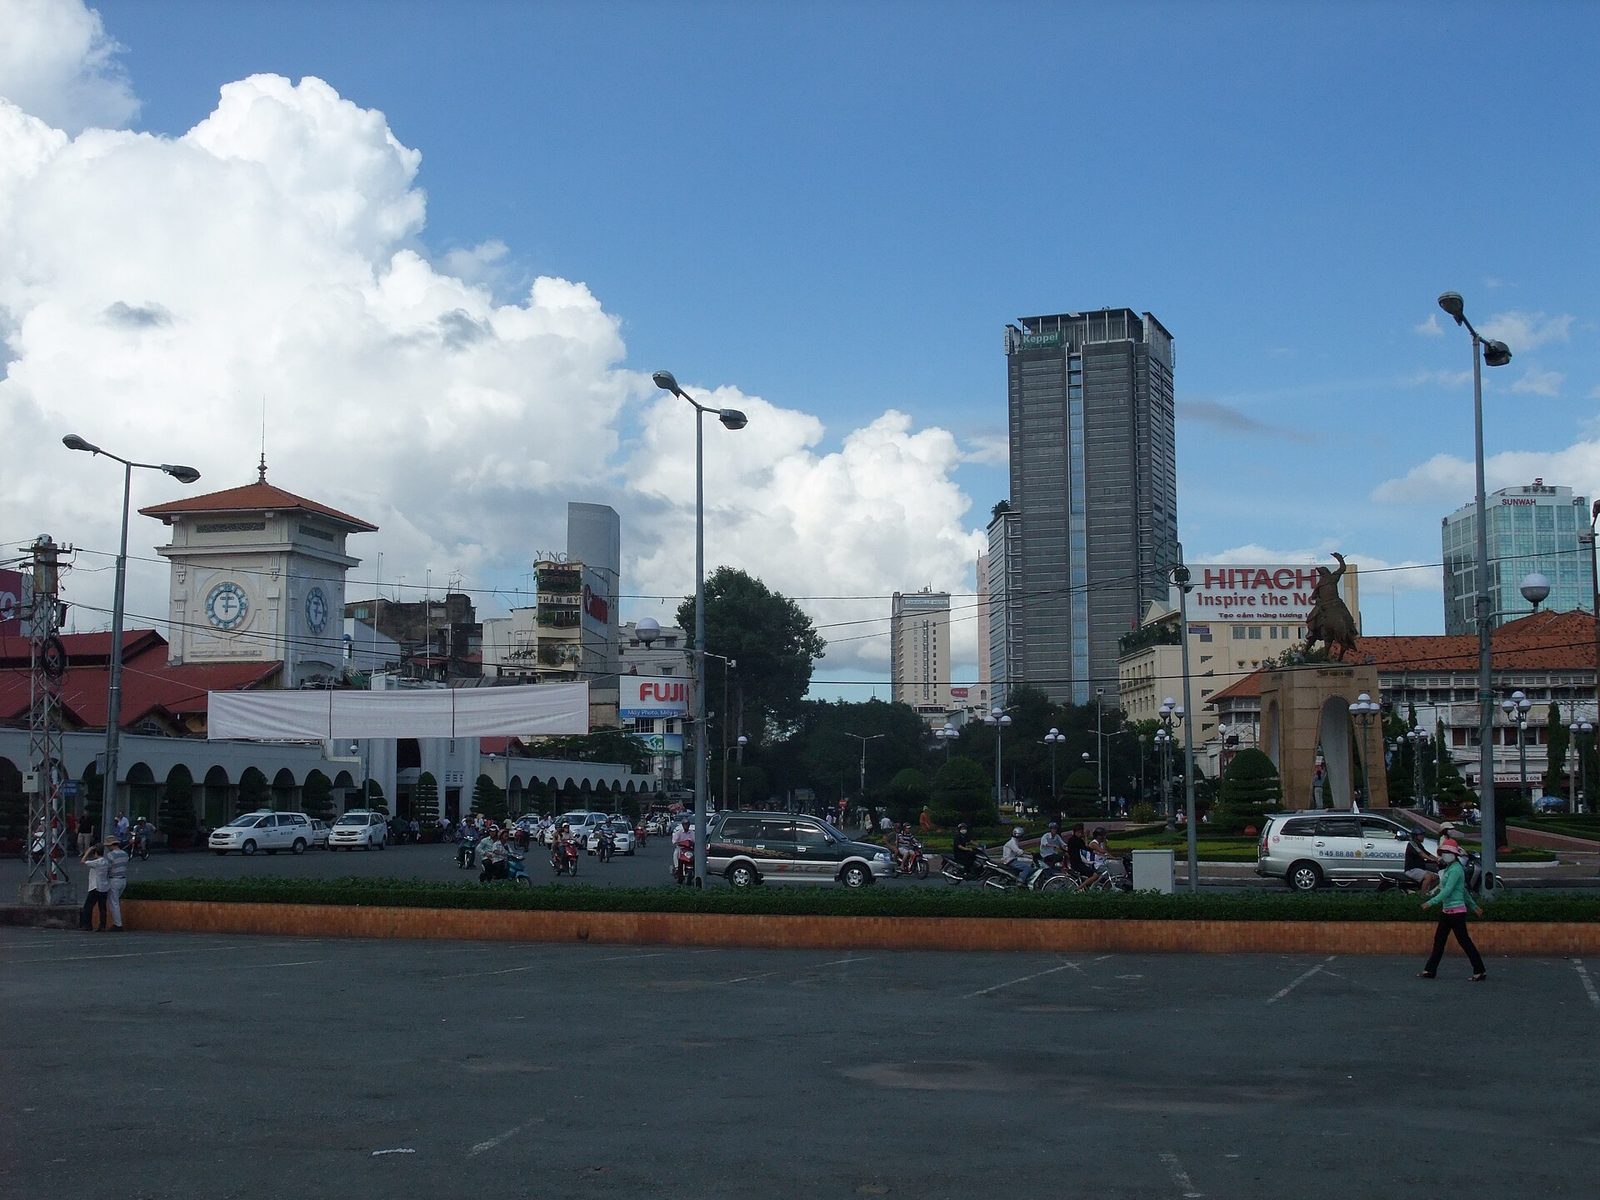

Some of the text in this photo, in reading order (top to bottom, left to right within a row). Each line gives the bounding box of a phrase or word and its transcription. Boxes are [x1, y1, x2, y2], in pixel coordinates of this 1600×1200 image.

[1023, 332, 1058, 343] Keppel
[1204, 568, 1317, 590] HITACH
[1197, 592, 1317, 609] Inspire the Ne
[640, 682, 689, 702] FUJI
